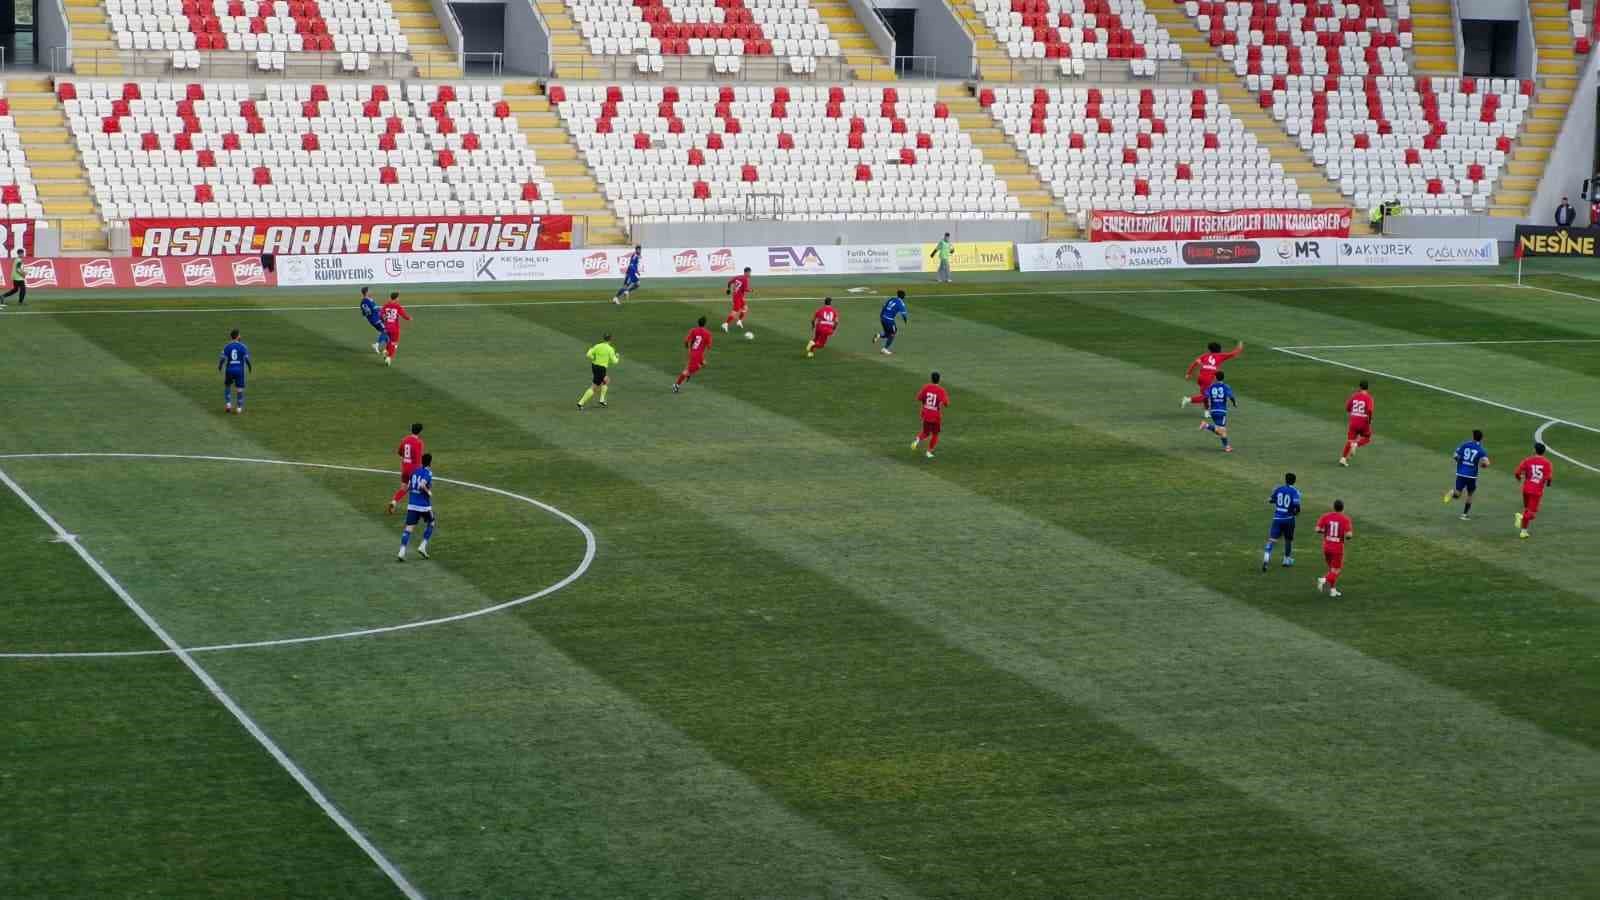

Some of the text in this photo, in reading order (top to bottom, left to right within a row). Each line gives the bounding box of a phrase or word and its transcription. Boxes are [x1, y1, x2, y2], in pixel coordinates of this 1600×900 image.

[141, 226, 361, 257] ASIRLARIN
[768, 247, 824, 266] EVA
[1295, 241, 1320, 258] MR
[185, 263, 212, 277] Bifa
[235, 263, 262, 277] Bifa
[406, 257, 465, 270] larende
[84, 264, 112, 278] Bifa
[135, 264, 161, 278] Bifa
[231, 349, 238, 360] 6
[1208, 355, 1216, 365] 4
[926, 392, 937, 406] 21
[1211, 387, 1224, 399] 93
[1353, 399, 1366, 413] 22
[1464, 447, 1478, 462] 97
[1531, 464, 1544, 480] 15
[1277, 493, 1290, 508] 80
[1329, 521, 1339, 537] 11
